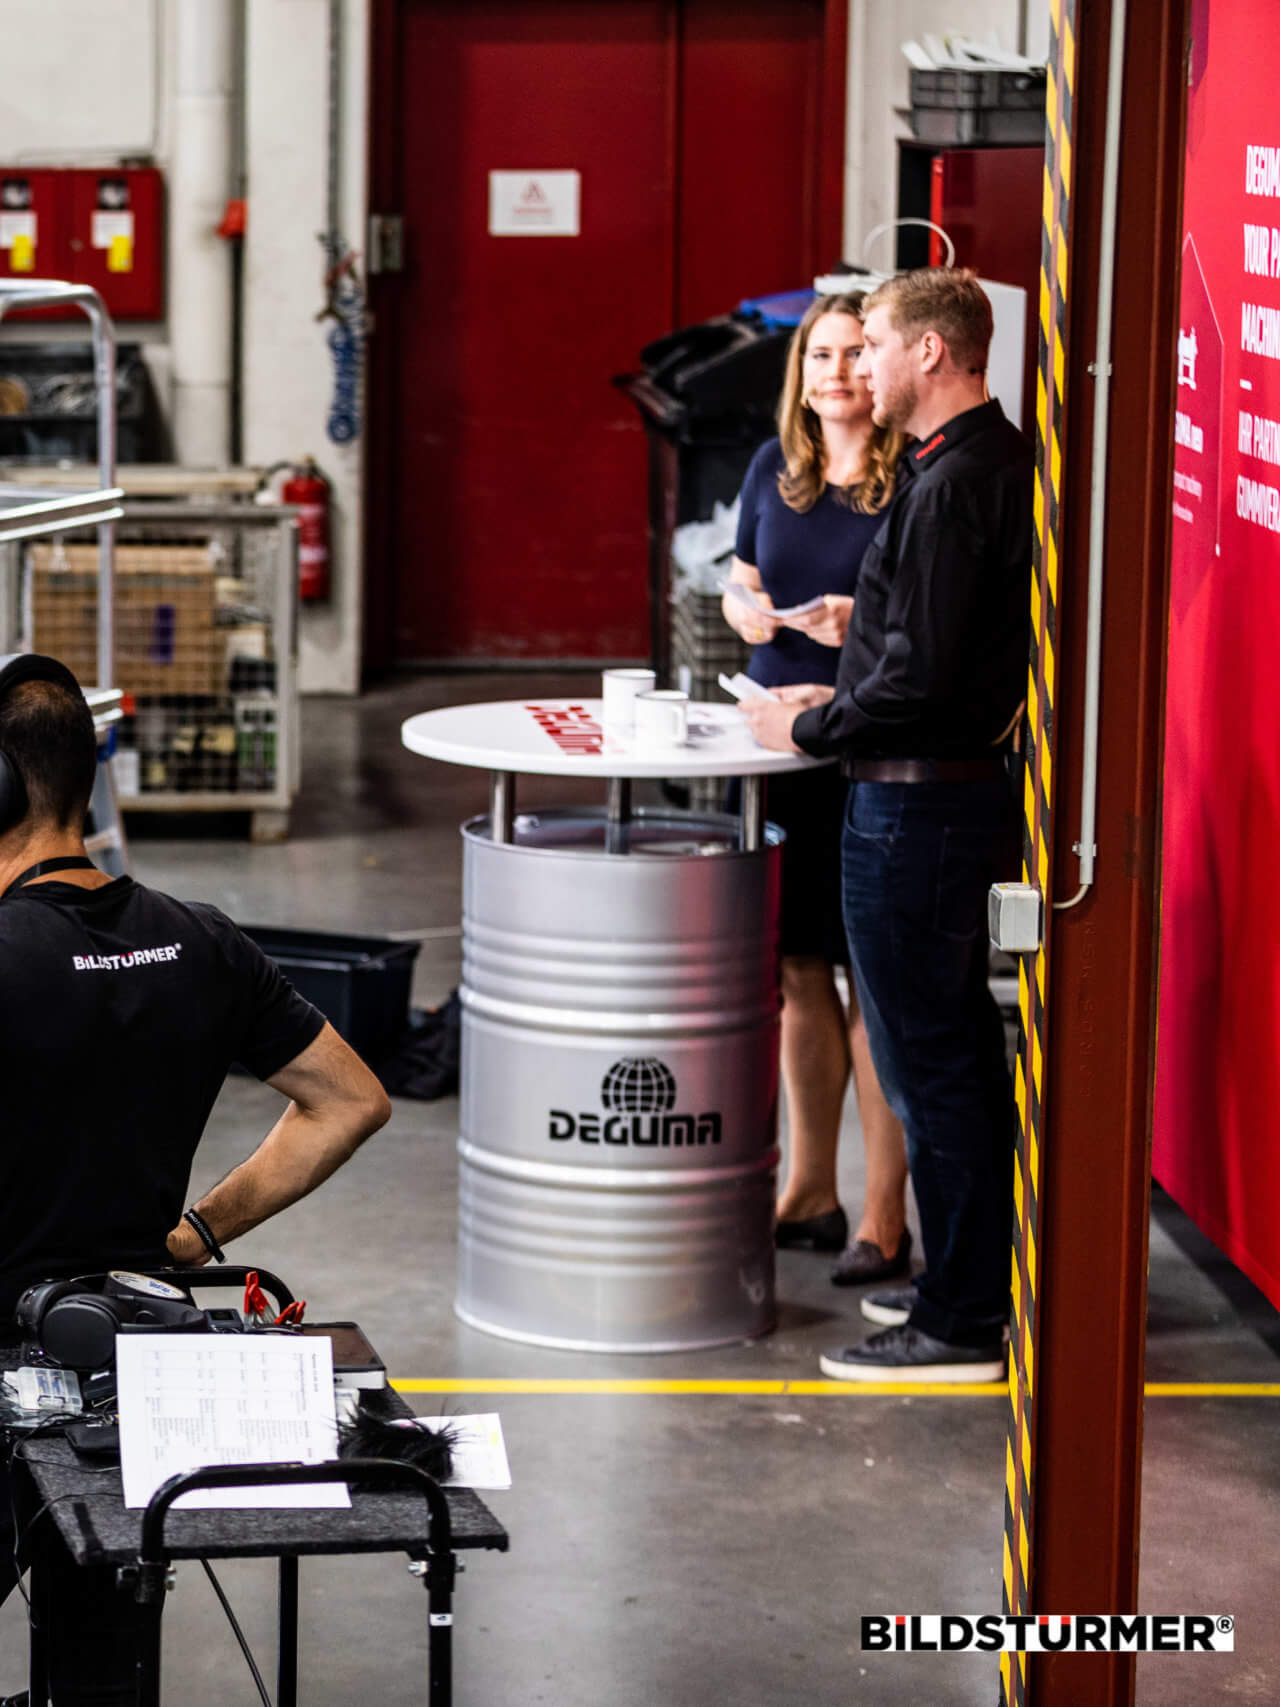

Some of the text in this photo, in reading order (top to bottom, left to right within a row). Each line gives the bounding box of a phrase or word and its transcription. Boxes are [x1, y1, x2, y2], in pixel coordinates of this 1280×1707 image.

[1243, 223, 1269, 277] YOUR
[1236, 474, 1280, 534] GUMMIVER
[548, 1109, 723, 1147] DEGUMA
